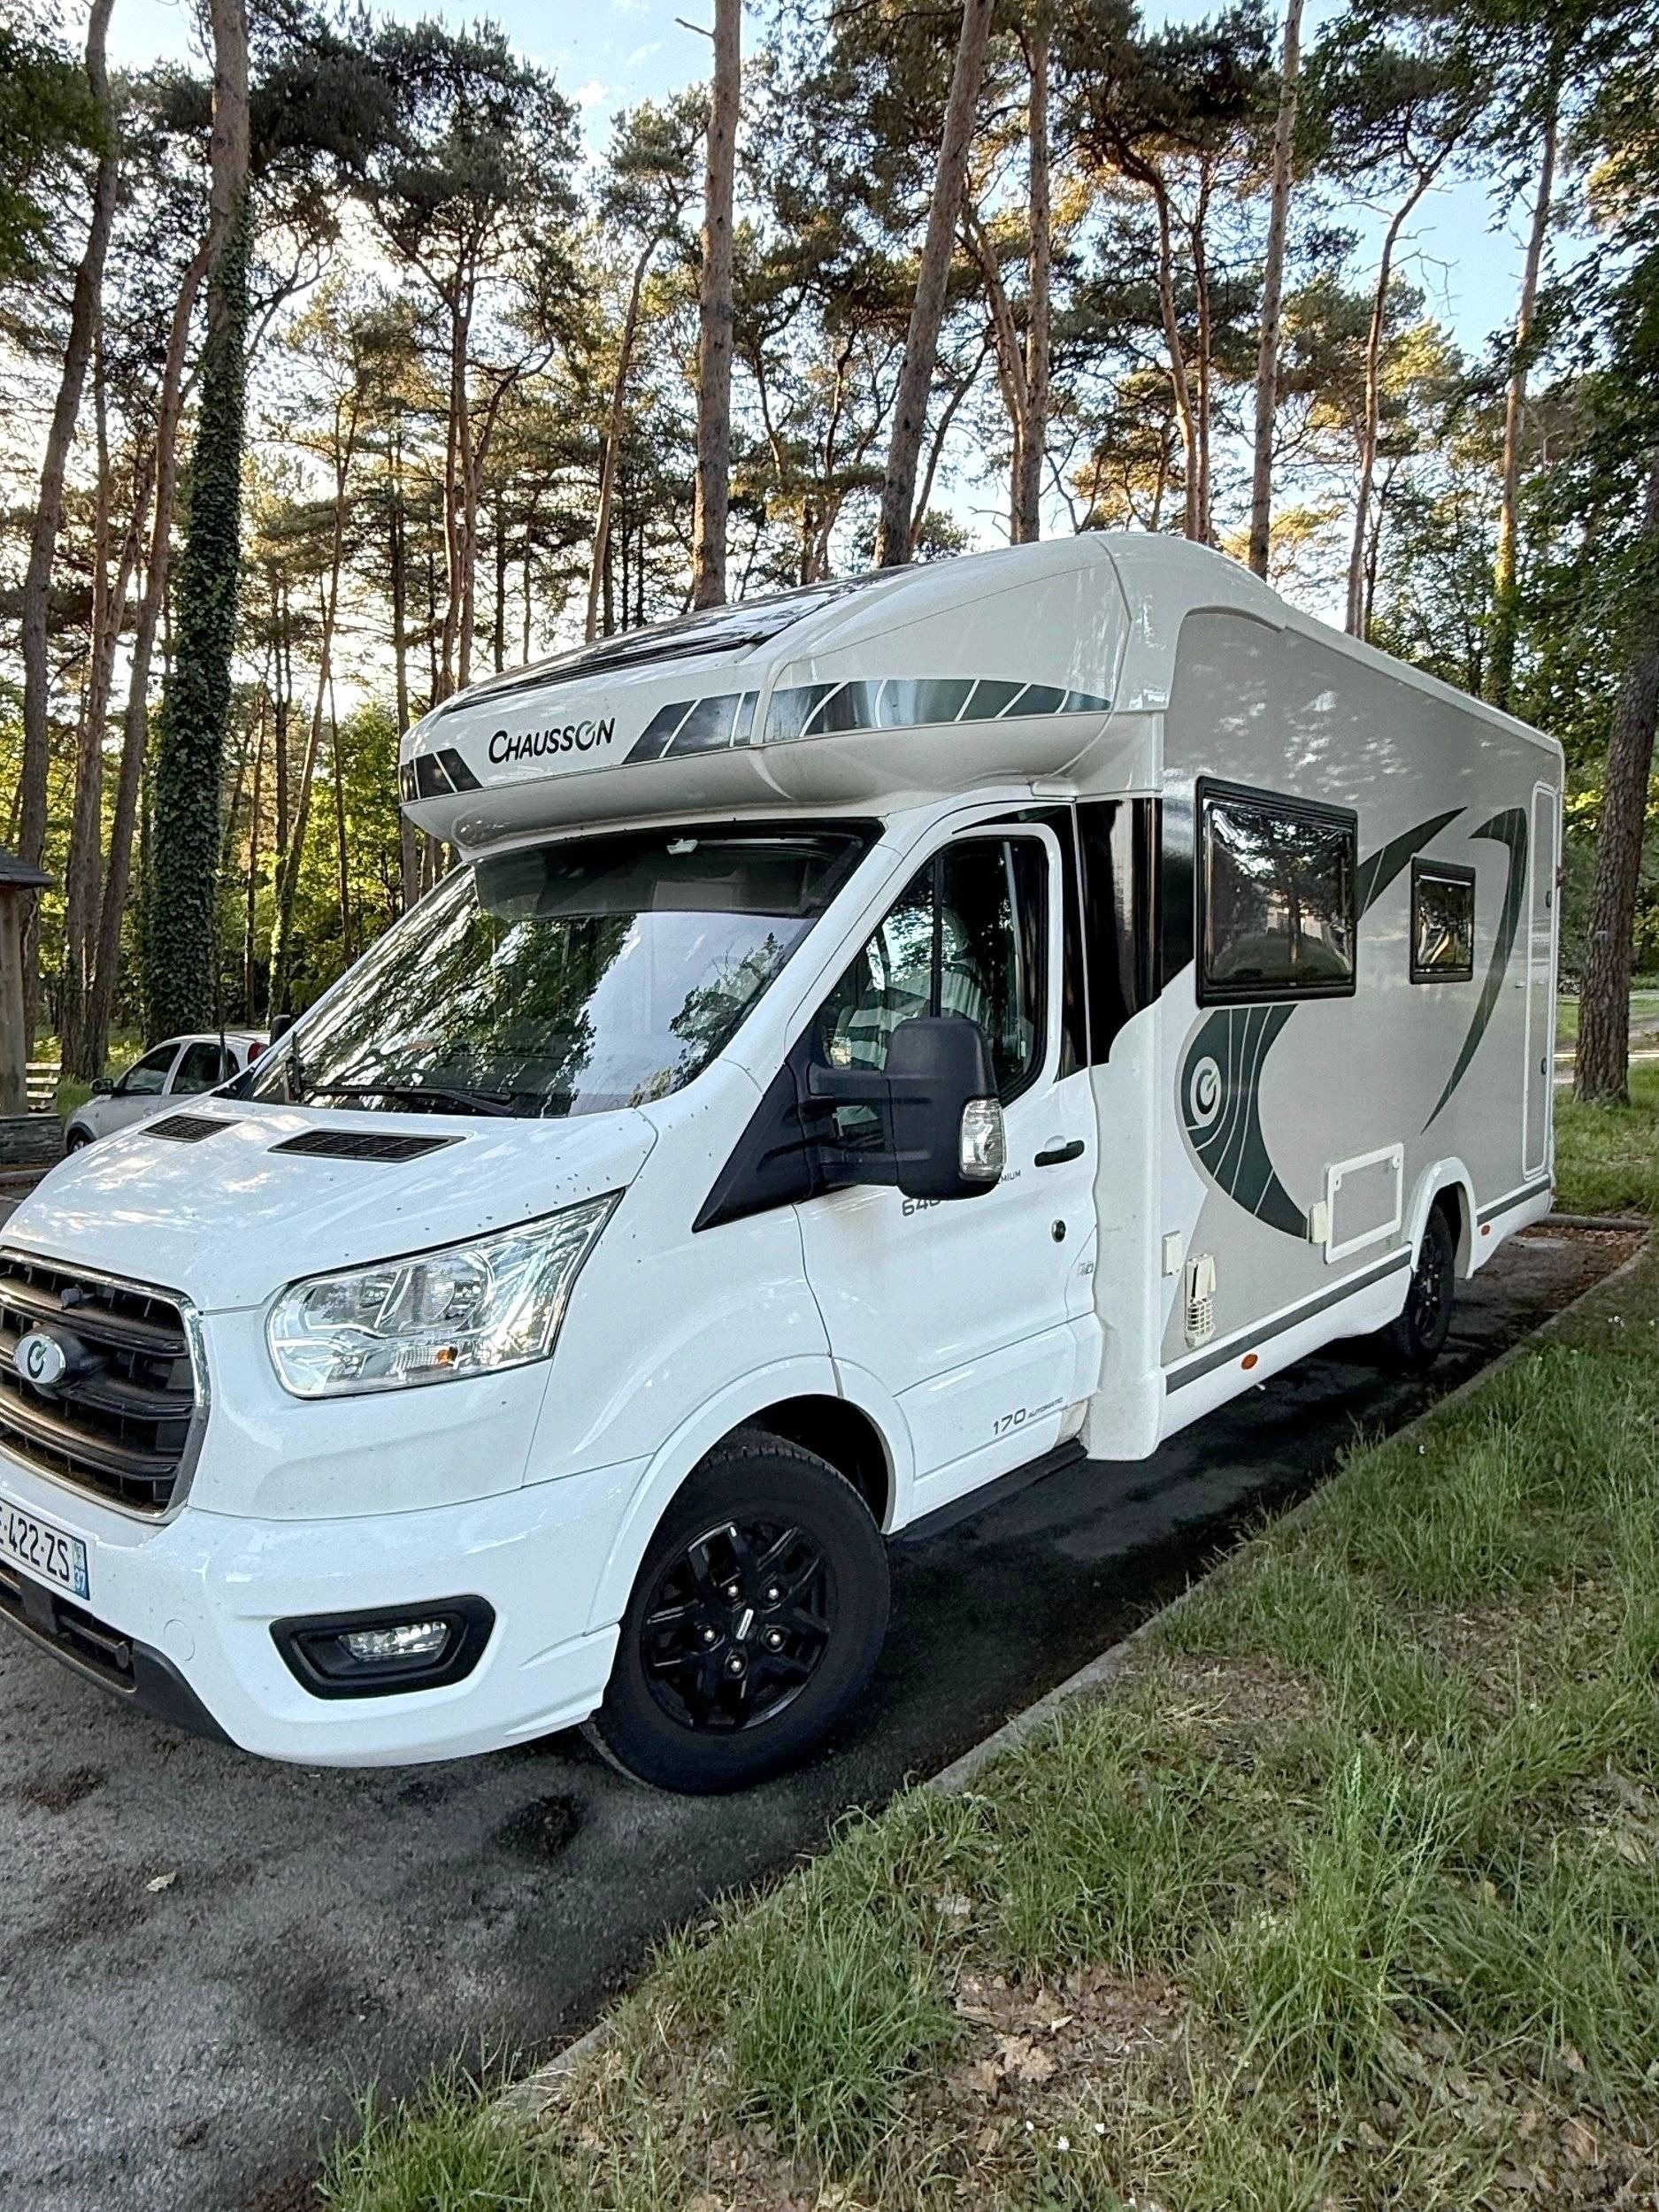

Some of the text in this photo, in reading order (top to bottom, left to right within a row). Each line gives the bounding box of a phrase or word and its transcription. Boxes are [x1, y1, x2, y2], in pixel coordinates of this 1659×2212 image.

[489, 718, 616, 764] CHAUSSON
[1001, 1169, 1021, 1182] MIUM
[994, 1409, 1026, 1435] 170
[0, 1505, 69, 1582] -422-ZS
